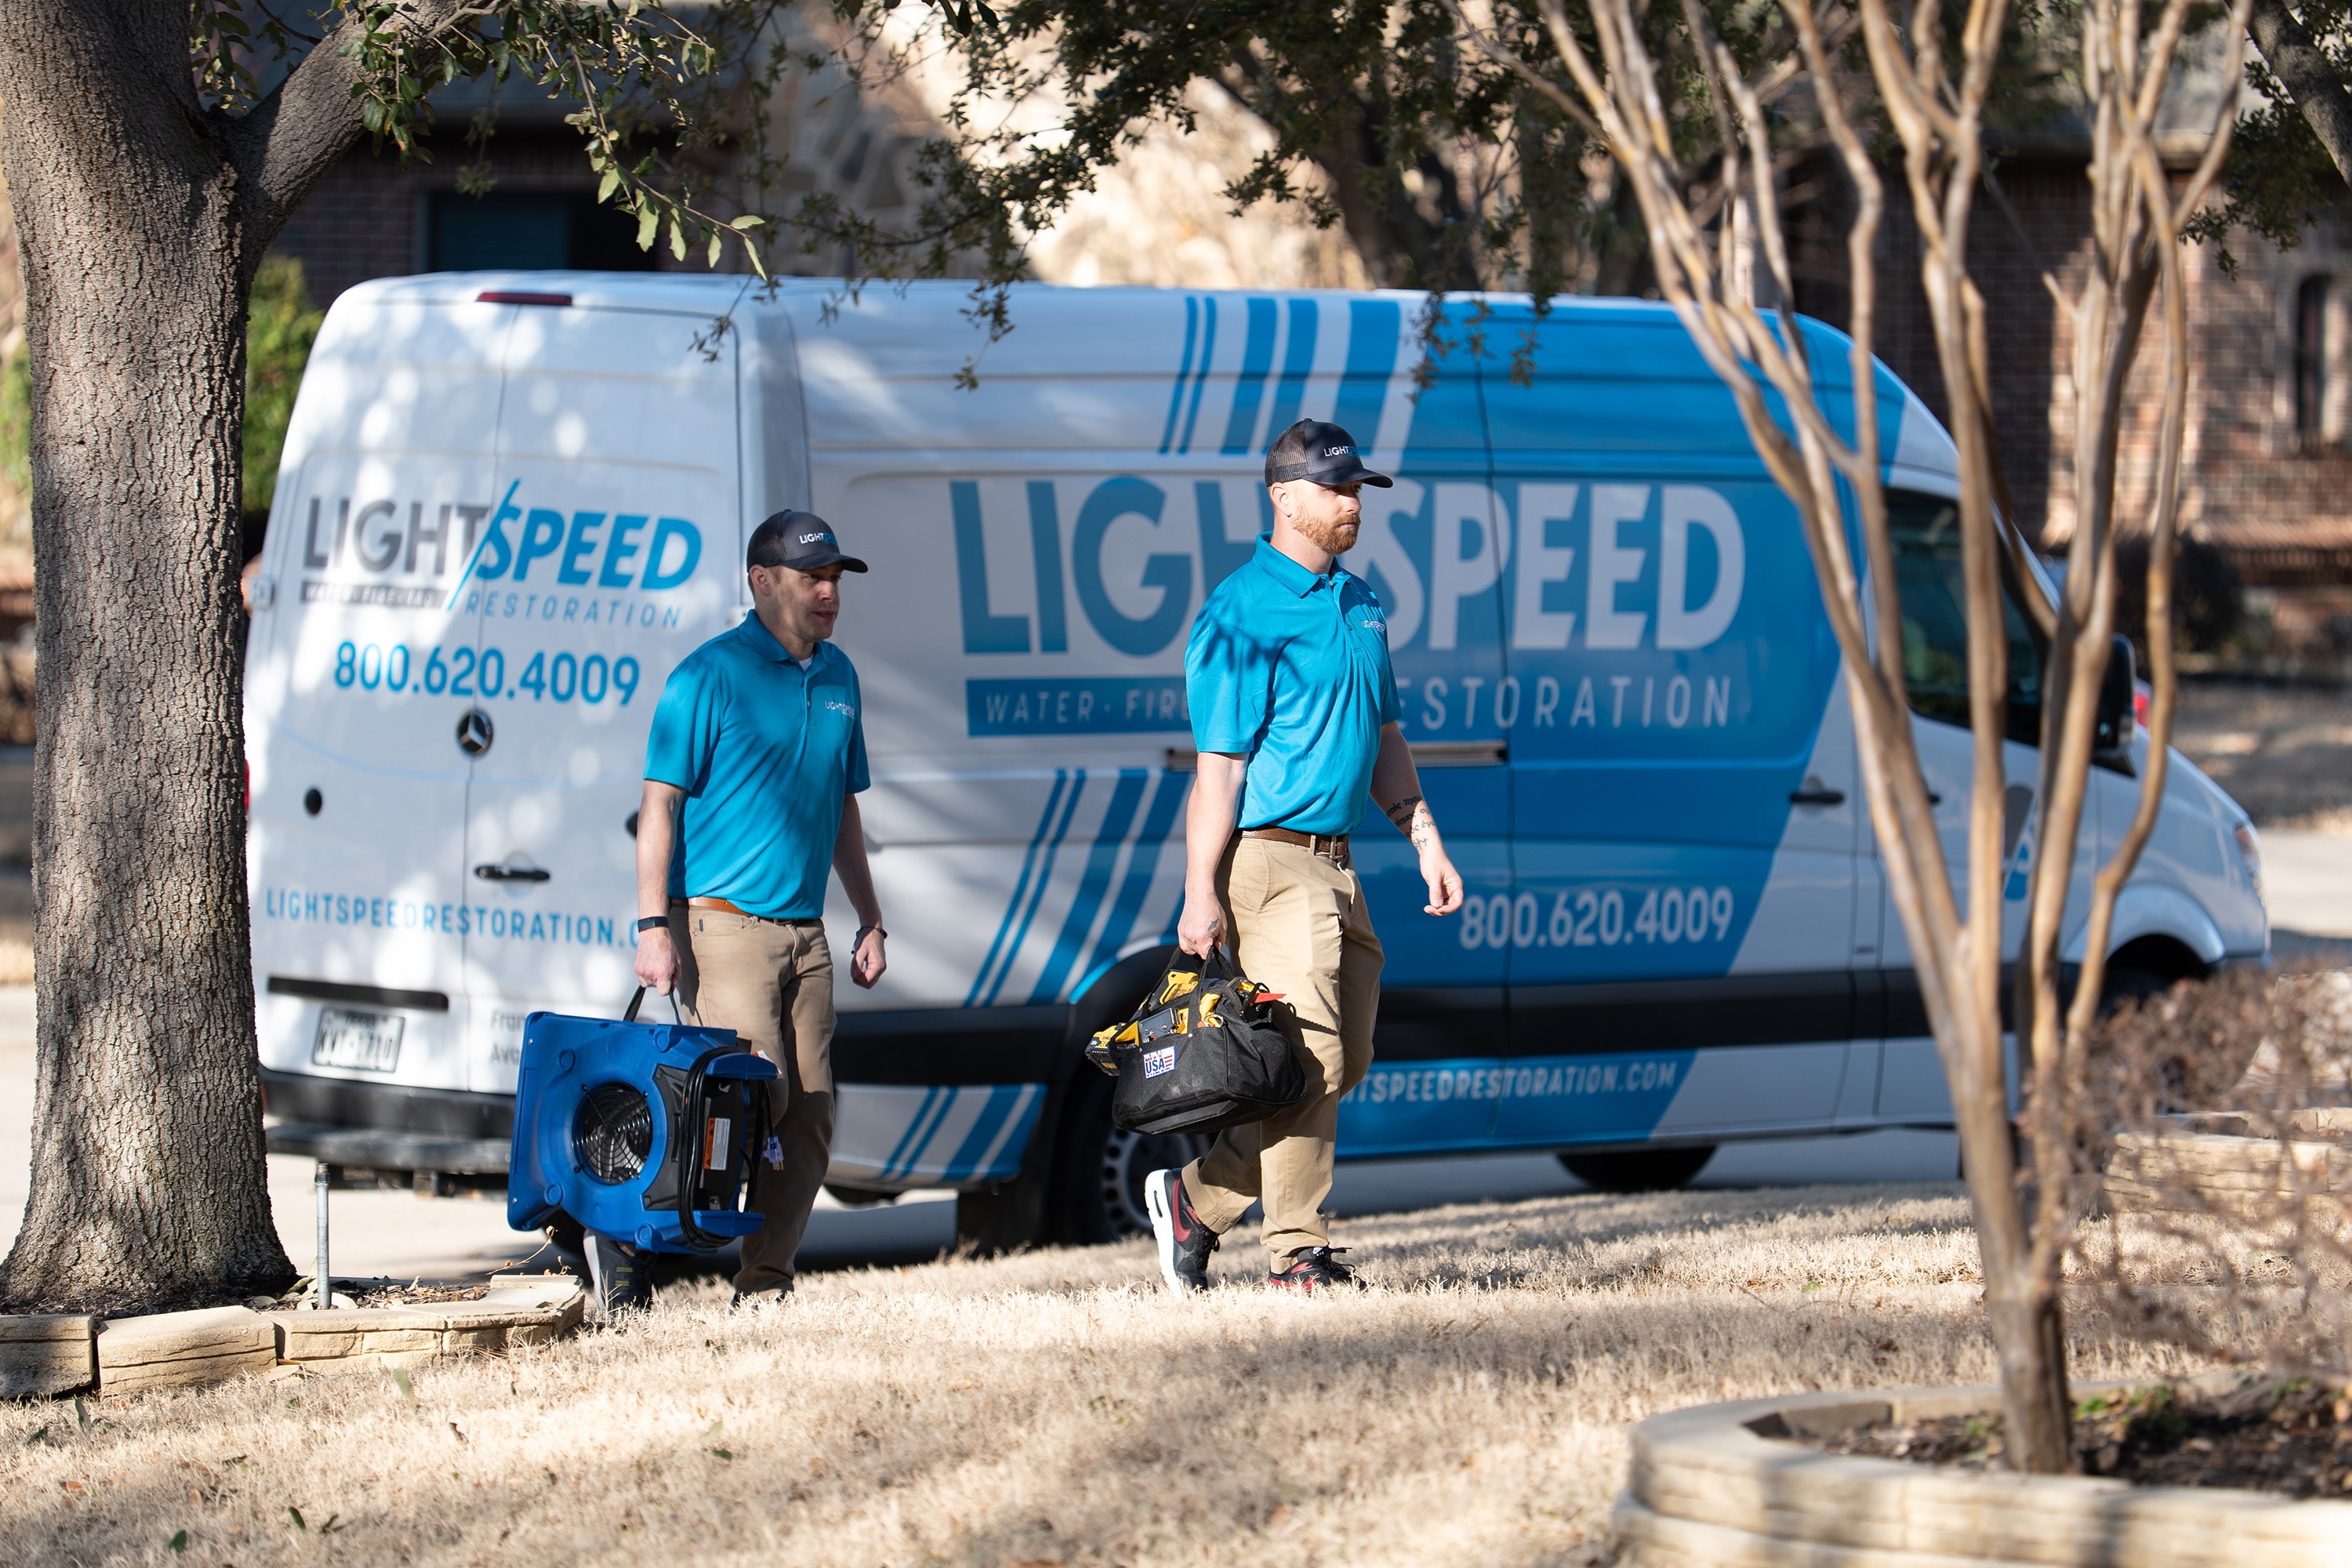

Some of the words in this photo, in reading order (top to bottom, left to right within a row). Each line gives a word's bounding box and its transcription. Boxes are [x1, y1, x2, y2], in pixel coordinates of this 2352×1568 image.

[949, 475, 1746, 659] LIGHSPEED
[466, 590, 681, 629] RESTORATION
[334, 641, 640, 706] 800.620.4009
[985, 690, 1093, 724] WATER
[1459, 886, 1734, 950] 800.620.4009
[1145, 1058, 1165, 1073] USA
